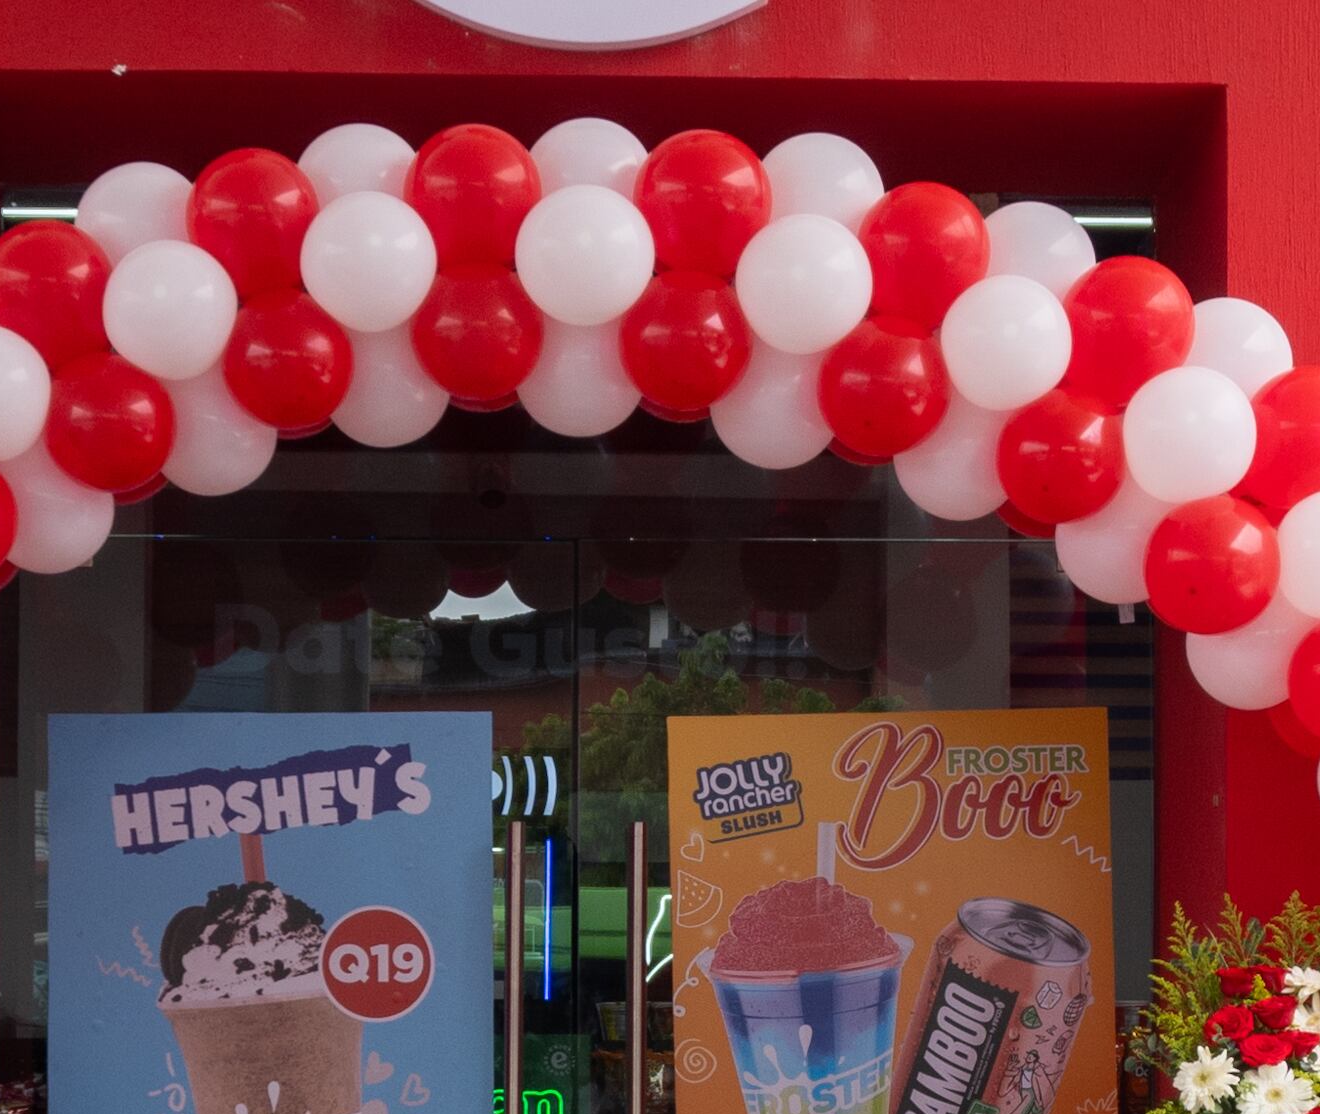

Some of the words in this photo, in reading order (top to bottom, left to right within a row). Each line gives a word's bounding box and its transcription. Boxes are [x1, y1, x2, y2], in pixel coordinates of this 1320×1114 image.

[696, 755, 785, 799] JOLLY
[946, 745, 1088, 775] FROSTER
[703, 781, 796, 818] rancher
[720, 810, 782, 834] SLUSH
[328, 943, 425, 983] Q19
